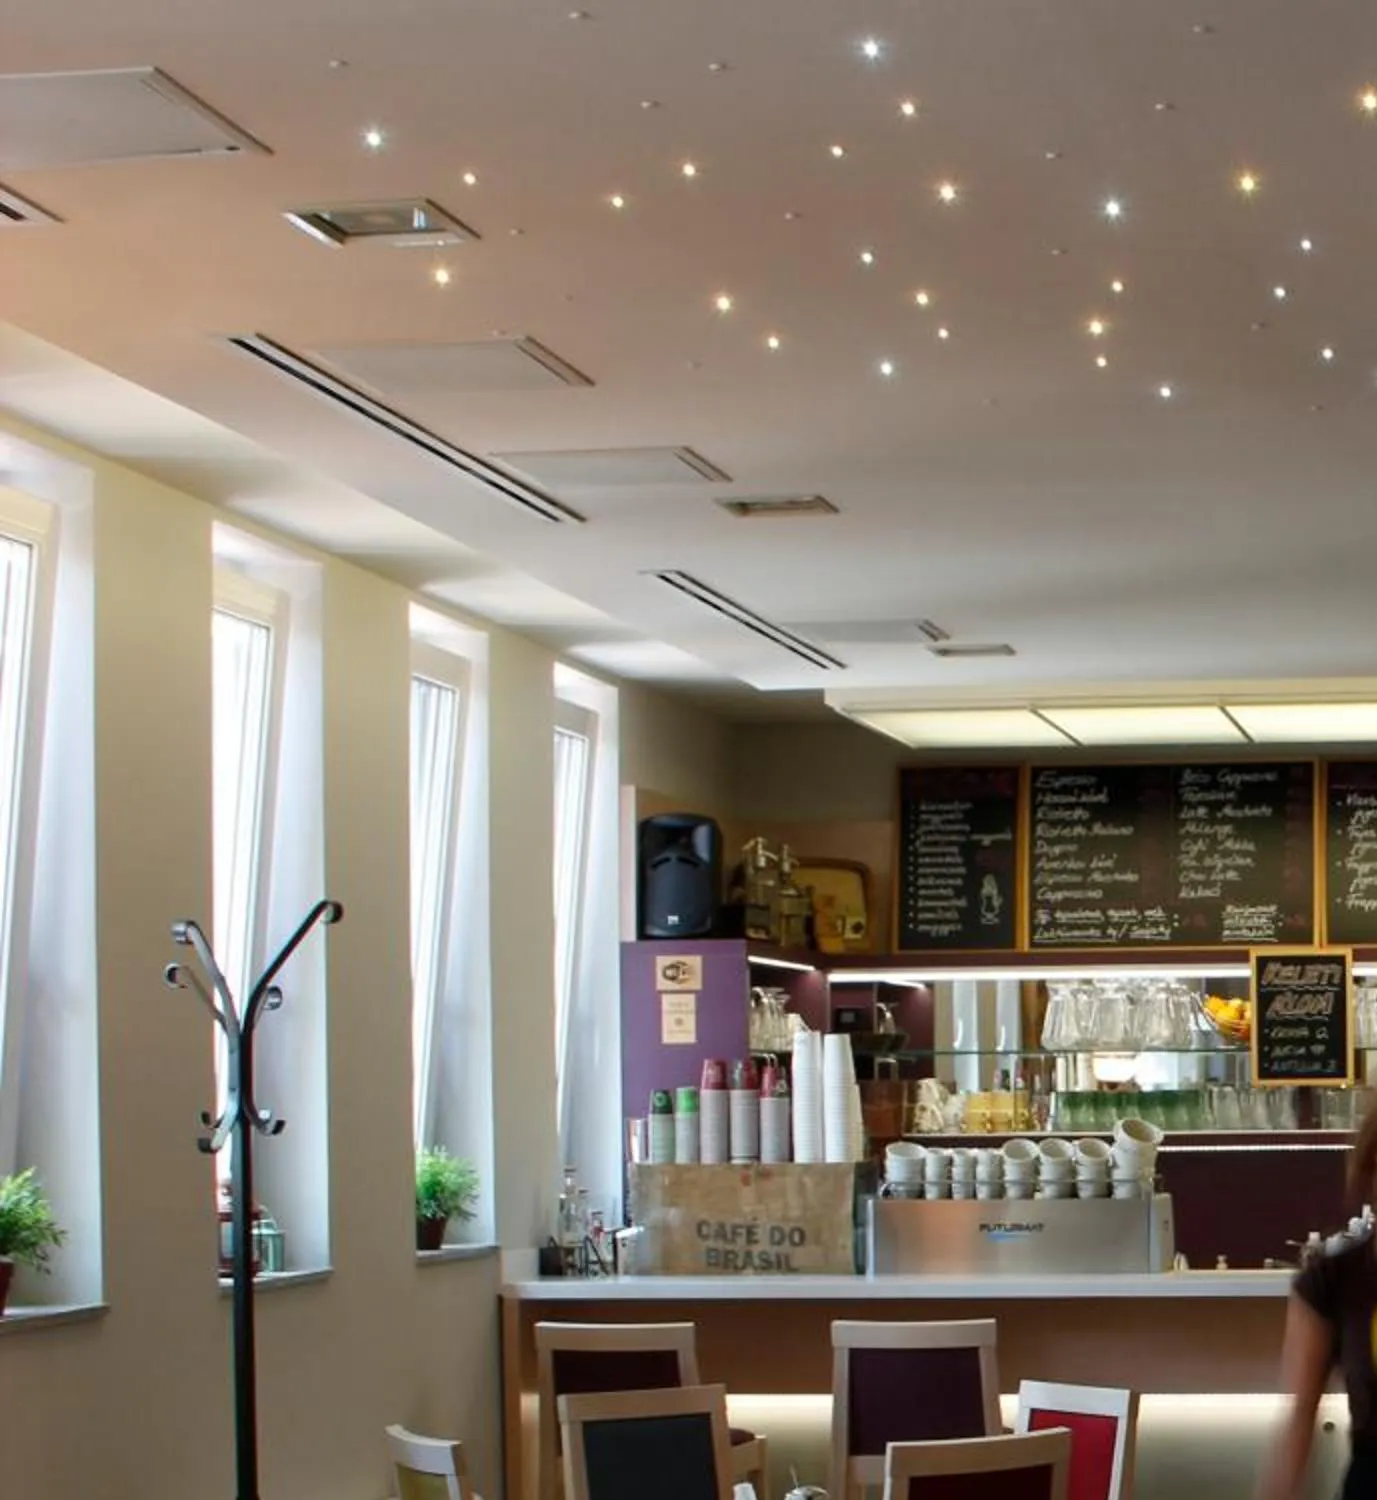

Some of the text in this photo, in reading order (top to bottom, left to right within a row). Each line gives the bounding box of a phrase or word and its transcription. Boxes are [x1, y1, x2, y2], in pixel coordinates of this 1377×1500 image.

[697, 1217, 806, 1247] CAFÉ DO
[707, 1248, 800, 1271] BRASIL
